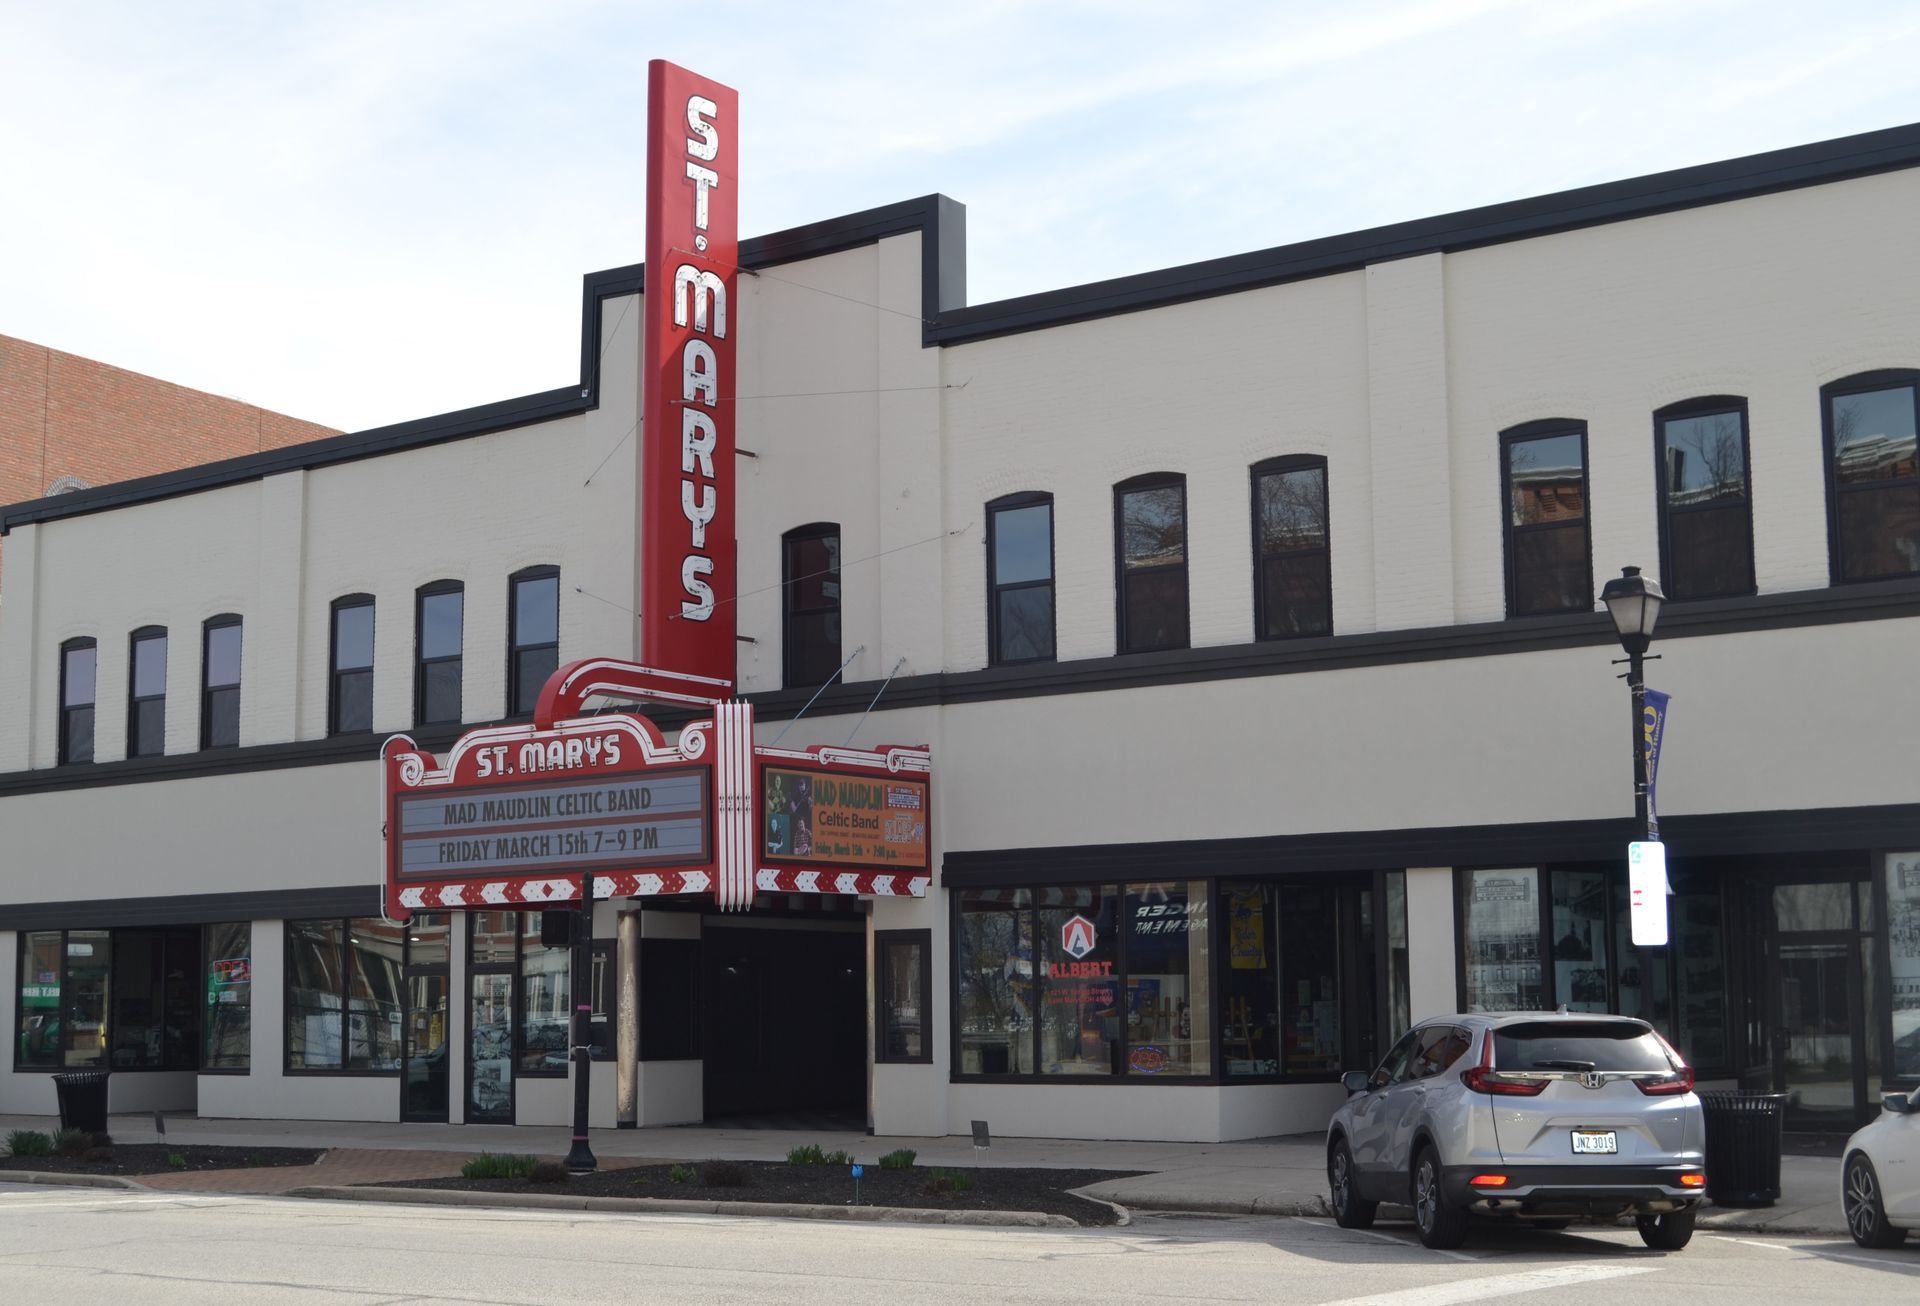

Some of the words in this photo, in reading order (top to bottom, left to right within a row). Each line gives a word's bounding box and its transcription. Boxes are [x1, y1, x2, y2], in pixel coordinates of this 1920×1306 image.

[686, 95, 718, 251] ST.
[674, 263, 727, 622] MARYS
[476, 745, 514, 778] ST.
[519, 734, 621, 773] MARYS
[444, 802, 477, 826] MAD
[482, 795, 550, 822] MAUDLIN
[556, 791, 602, 817] CELTIC
[607, 787, 652, 813] BAND
[819, 811, 849, 827] Celtic
[852, 814, 879, 830] Band
[439, 838, 490, 864] FRIDAY
[496, 834, 550, 860] MARCH
[557, 830, 588, 856] 15th
[632, 827, 659, 850] PM
[1049, 960, 1112, 979] ALBERT
[1575, 1137, 1591, 1149] JNZ
[1592, 1137, 1614, 1149] 3019
